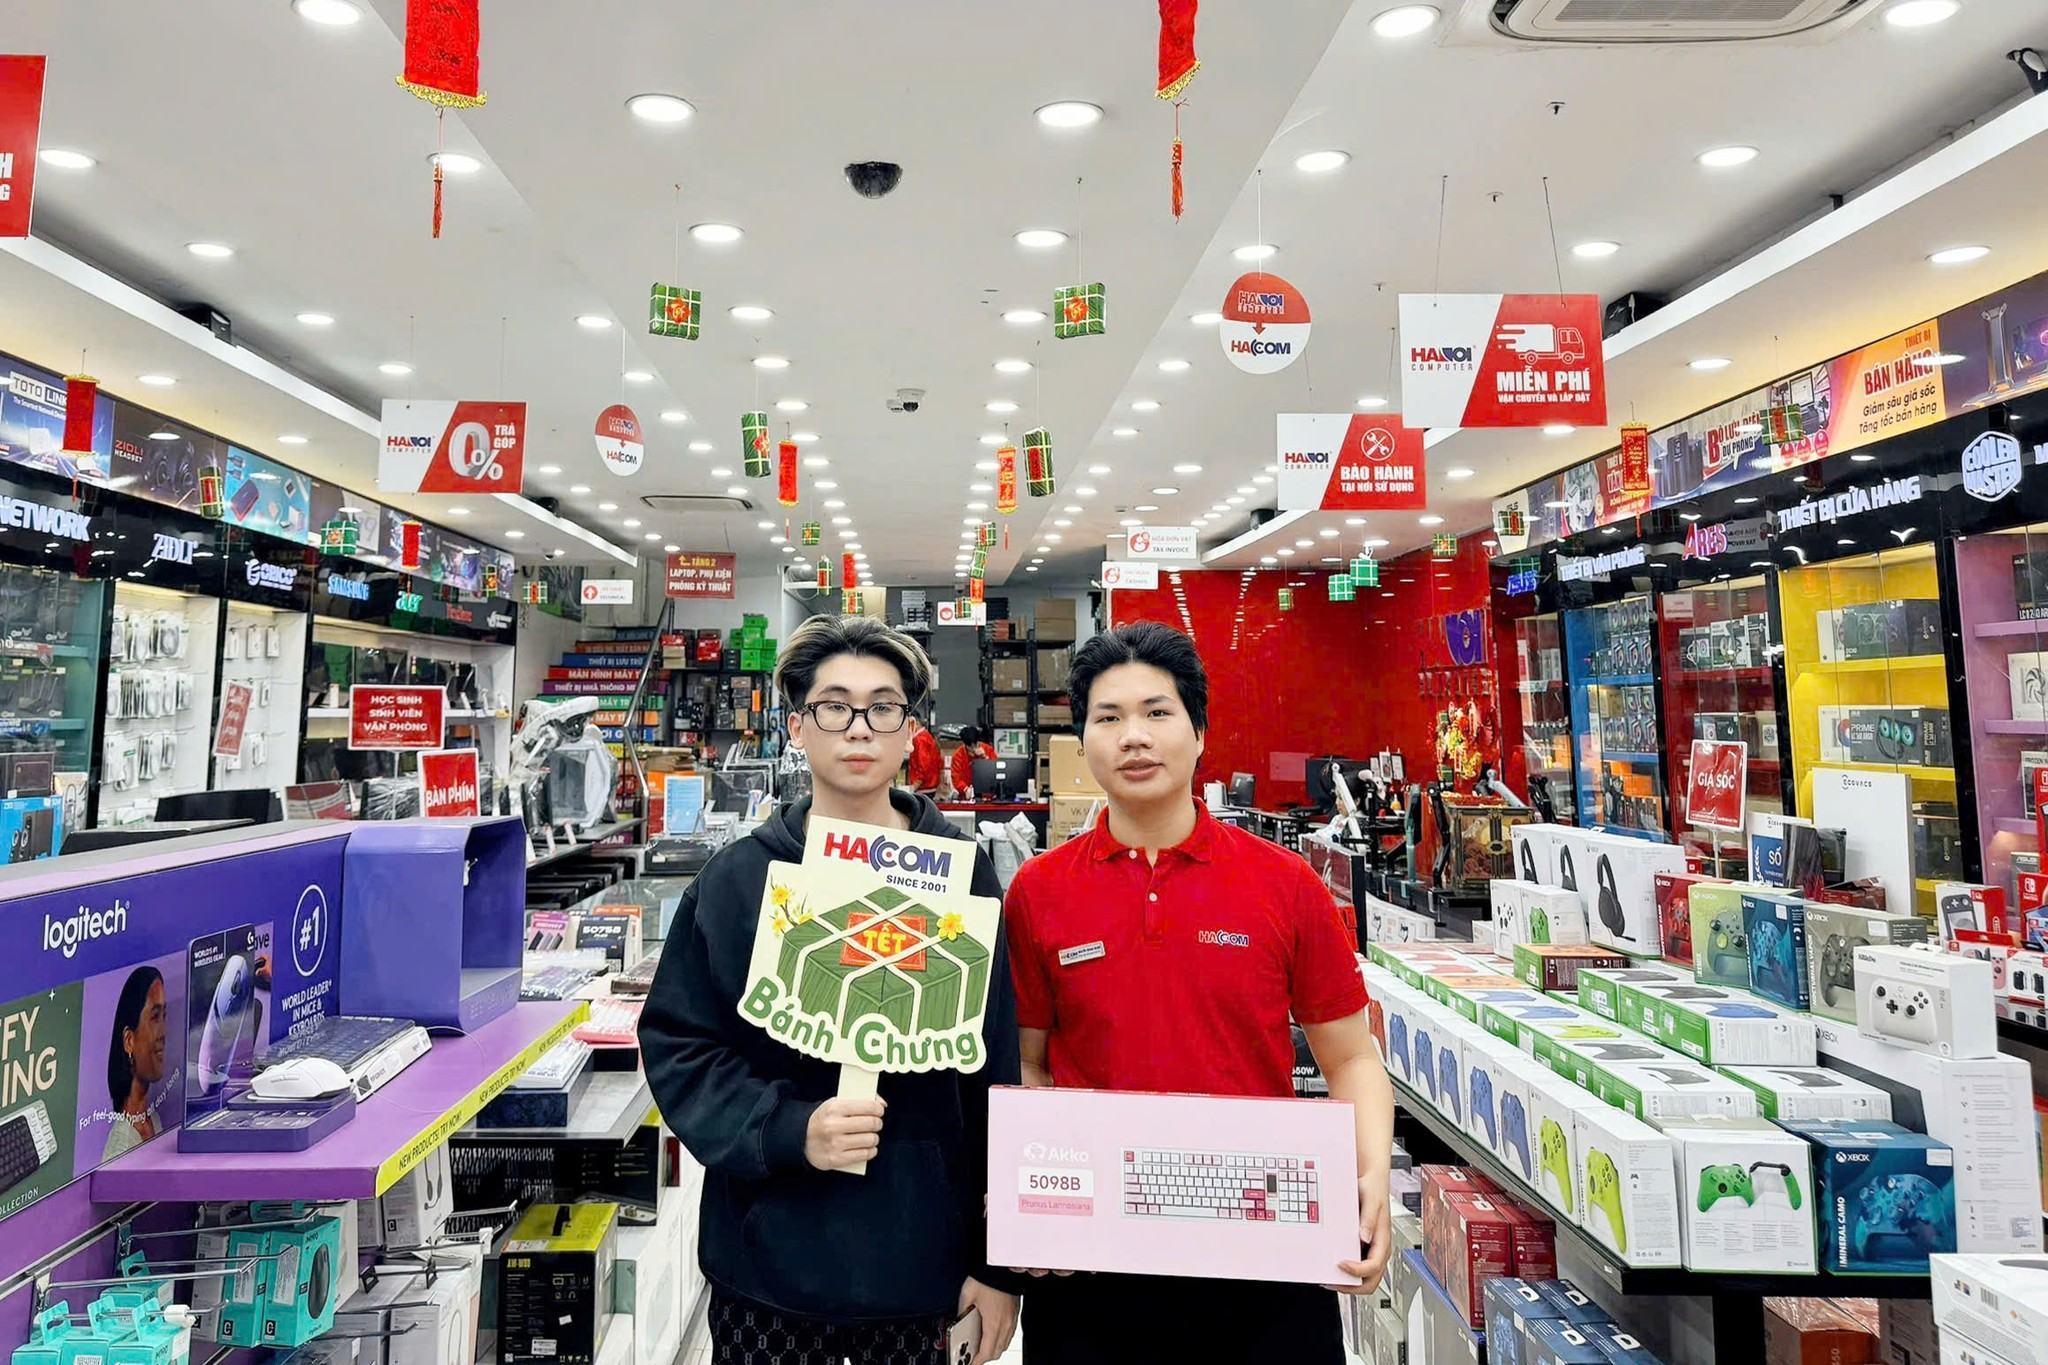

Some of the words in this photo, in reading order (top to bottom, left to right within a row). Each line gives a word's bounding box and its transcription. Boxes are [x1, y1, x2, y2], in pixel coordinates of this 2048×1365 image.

[1411, 363, 1473, 371] COMPUTER
[13, 376, 43, 397] TOTO
[1496, 366, 1548, 391] MIỄN
[1555, 368, 1591, 391] PHÍ
[1864, 363, 1891, 395] BÁN
[1863, 401, 1885, 417] Giảm
[1887, 395, 1901, 409] sâu
[1903, 388, 1918, 407] giá
[1920, 382, 1936, 399] sốc
[1896, 406, 1912, 421] bán
[1914, 401, 1937, 417] hàng
[448, 421, 504, 480] 0%
[1966, 437, 2018, 471] COOLER
[1341, 463, 1370, 481] BẢO
[1374, 464, 1414, 480] HÀNH
[1341, 482, 1356, 494] TẠI
[1389, 482, 1414, 494] DỤNG
[1777, 494, 1819, 533] THIẾT
[1819, 498, 1837, 525] BỊ
[1871, 477, 1922, 508] HÀNG
[1681, 522, 1728, 561] ARES
[327, 575, 370, 600] SAMSUNG
[590, 668, 612, 678] HÌNH
[614, 668, 633, 678] MÁY
[371, 695, 395, 705] HỌC
[396, 695, 422, 704] SINH
[369, 709, 395, 718] SINH
[397, 707, 423, 718] VIÊN
[596, 711, 617, 722] MÁY
[389, 720, 428, 731] PHÒNG
[1698, 769, 1714, 786] GIÁ
[1715, 769, 1735, 790] SỐC
[425, 785, 447, 808] BÀN
[448, 781, 475, 804] PHÍM
[886, 874, 919, 889] SINCE
[920, 880, 948, 894] 2001
[43, 900, 127, 959] logitech
[299, 906, 320, 951] #1
[282, 989, 307, 1012] WORLD
[292, 1006, 300, 1022] IN
[299, 1002, 317, 1019] MICE
[743, 976, 834, 1053] Bánh
[854, 1020, 979, 1065] Chưng
[79, 1114, 92, 1131] For
[92, 1107, 125, 1123] feel-good
[125, 1111, 147, 1126] typing
[154, 1089, 168, 1110] day
[399, 1152, 412, 1171] NEW
[1048, 1147, 1089, 1162] Akko
[1847, 1153, 1871, 1162] XBOX
[1030, 1174, 1081, 1191] 5098B
[0, 1186, 40, 1214] OLLECTION
[1836, 1196, 1847, 1223] CAMO
[1839, 1224, 1848, 1268] MINERAL
